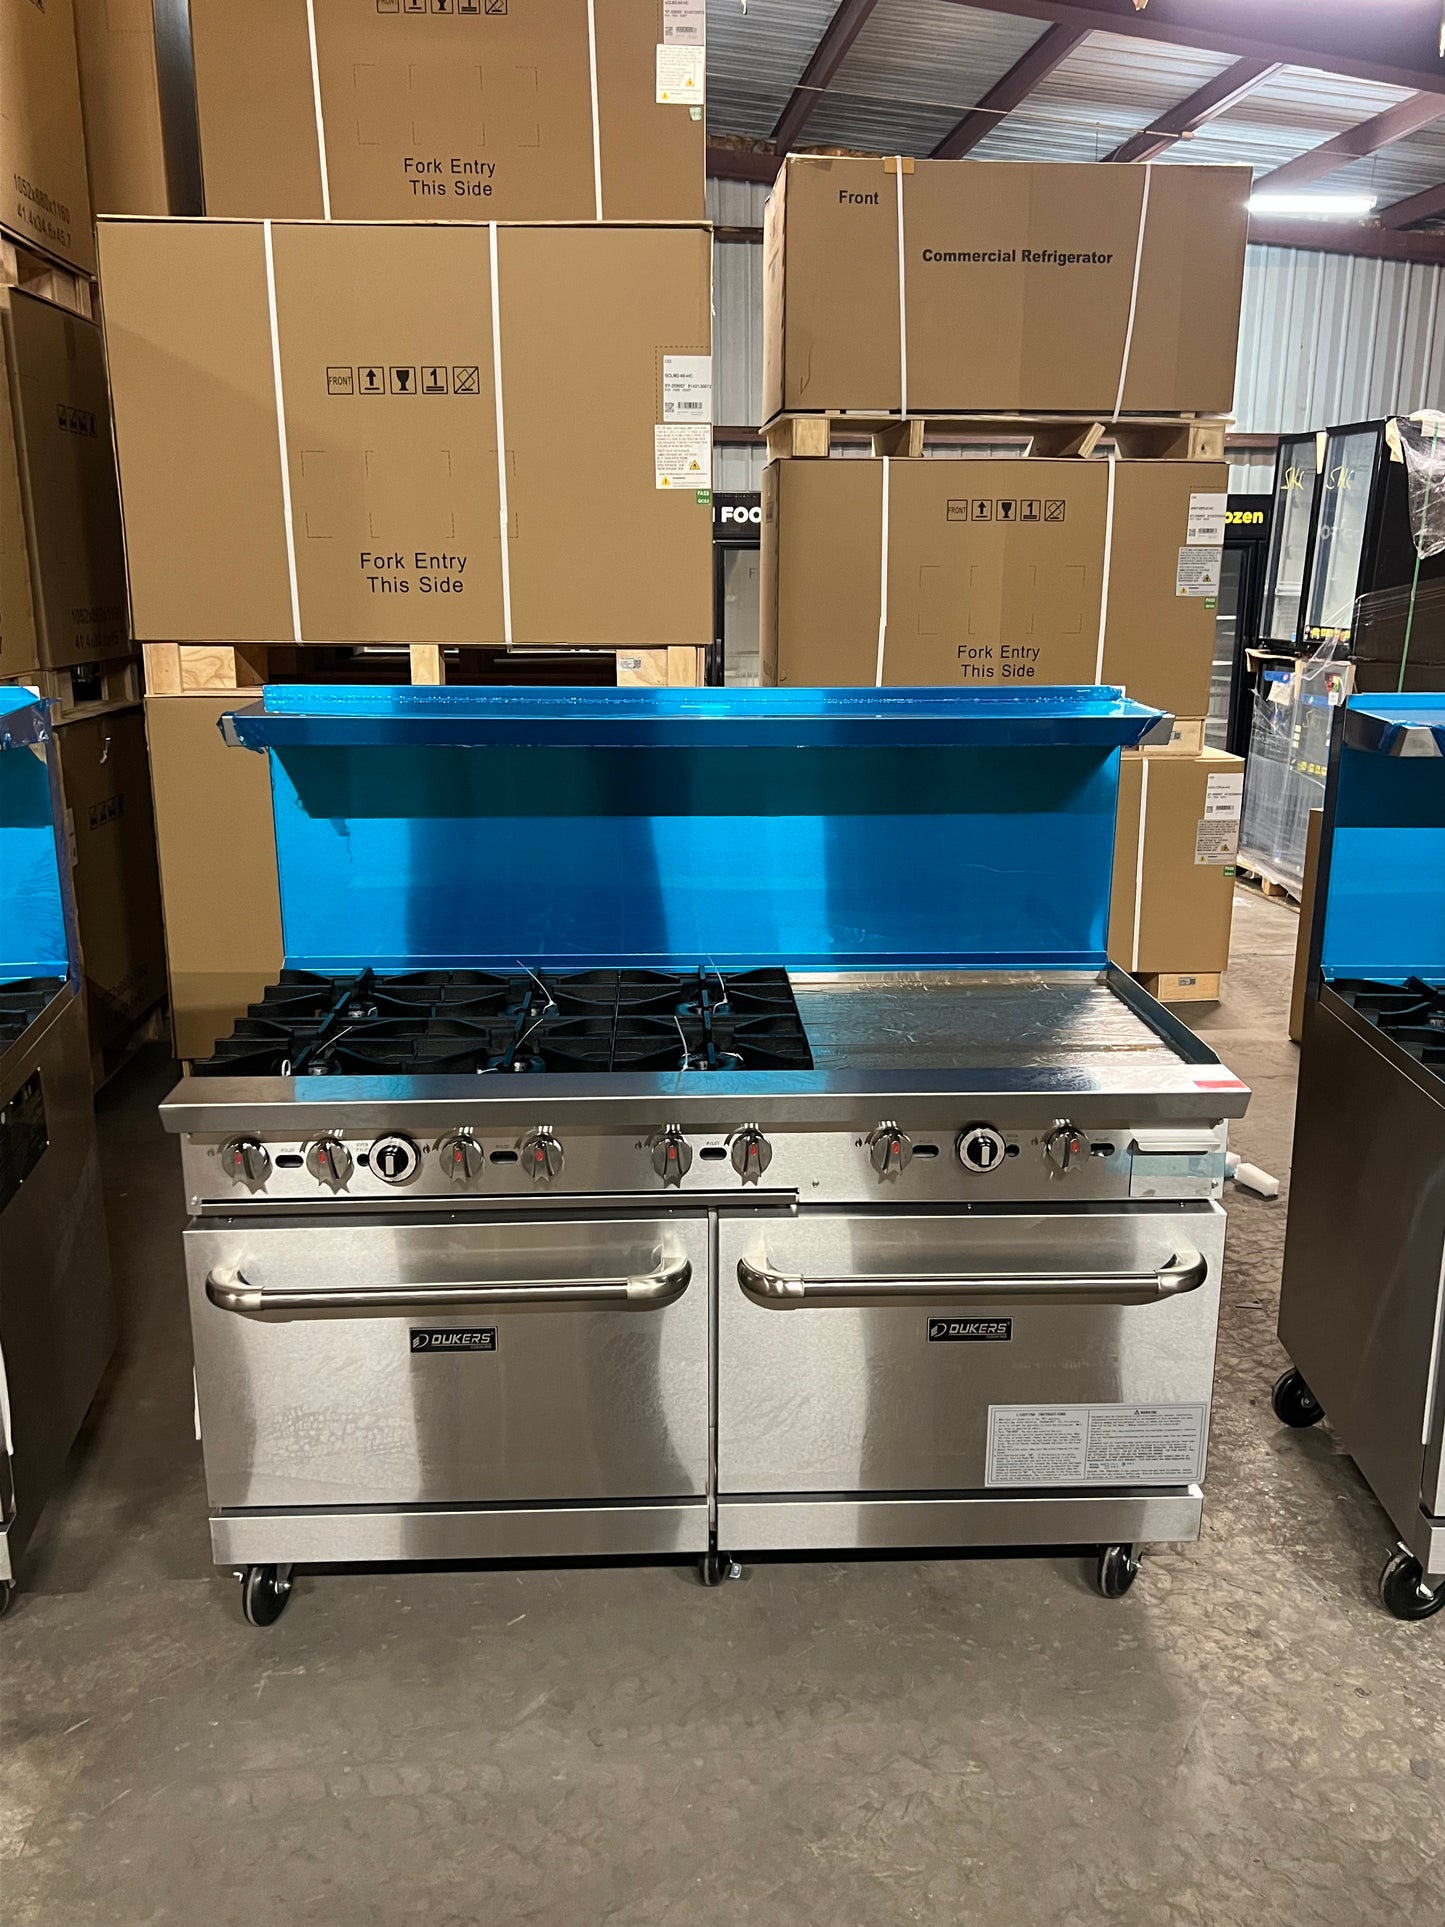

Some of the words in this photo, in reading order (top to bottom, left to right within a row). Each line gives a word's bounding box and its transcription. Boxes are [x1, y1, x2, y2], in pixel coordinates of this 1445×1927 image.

[404, 158, 442, 173] Fork
[451, 159, 495, 178] Entry
[409, 180, 446, 196] This
[454, 181, 492, 196] Side
[838, 190, 879, 205] Front
[922, 249, 1015, 263] Commercial
[1021, 250, 1113, 266] Refrigerator
[328, 376, 351, 386] FRONT
[360, 552, 405, 569] Fork
[415, 552, 467, 573] Entry
[367, 576, 410, 593] This
[419, 577, 464, 593] Side
[957, 645, 993, 659] Fork
[1000, 645, 1040, 662] Entry
[961, 664, 994, 677] This
[1001, 664, 1035, 677] Side
[949, 1323, 1008, 1334] DUKERS
[431, 1333, 491, 1344] DUKERS
